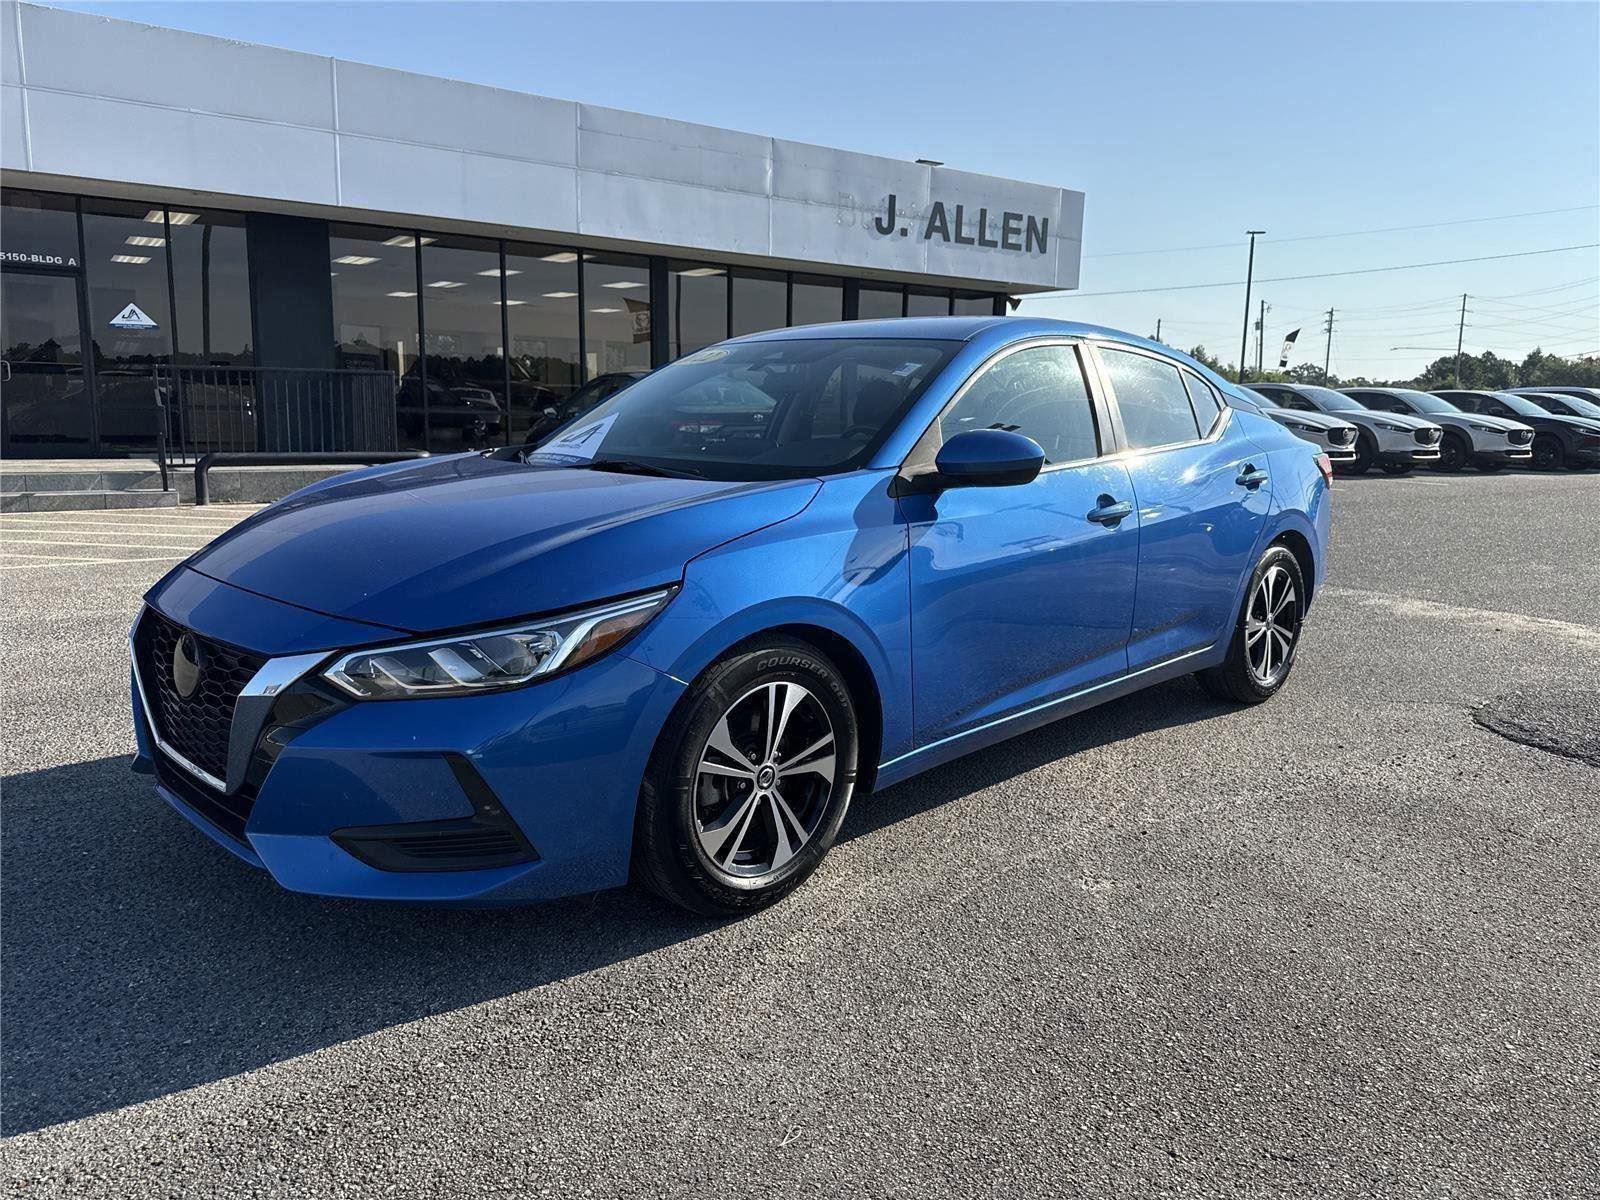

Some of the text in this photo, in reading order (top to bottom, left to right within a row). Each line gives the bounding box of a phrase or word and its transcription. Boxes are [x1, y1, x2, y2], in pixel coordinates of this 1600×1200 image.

[875, 193, 1050, 254] J. ALLEN
[0, 251, 77, 266] 5150-BLDG A
[757, 656, 828, 679] COURSER
